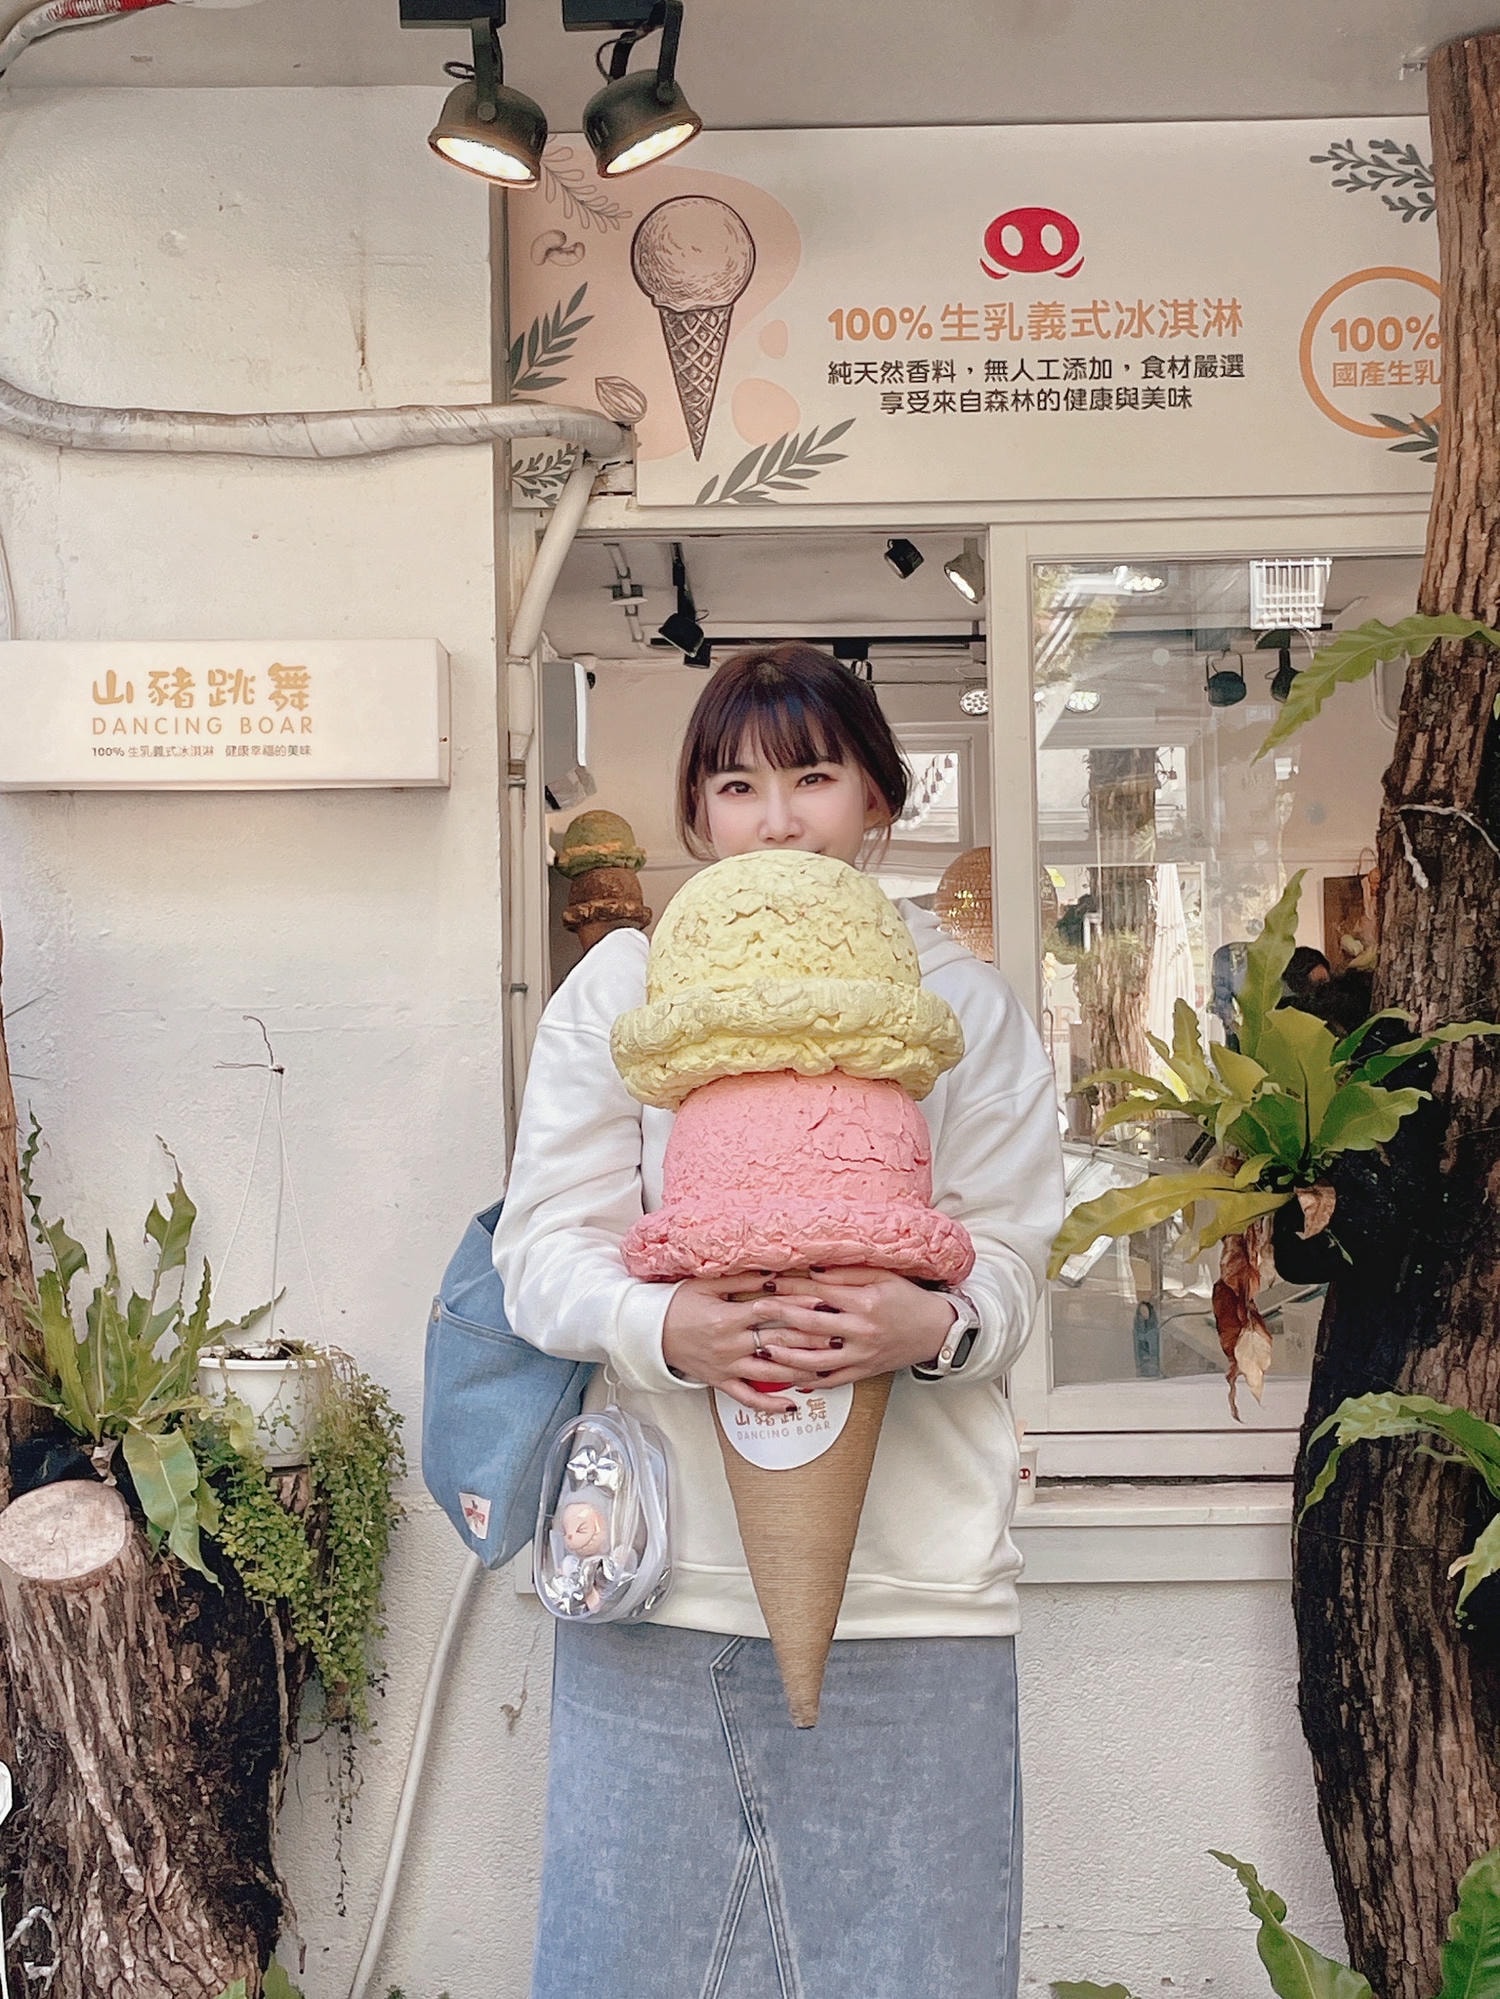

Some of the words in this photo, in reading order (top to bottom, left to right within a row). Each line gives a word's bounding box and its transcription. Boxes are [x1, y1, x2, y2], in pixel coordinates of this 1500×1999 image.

[1330, 313, 1441, 352] 100%
[1332, 359, 1441, 387] 國產生乳
[880, 385, 1193, 415] 享受來自森林的健康與美味
[92, 662, 312, 712] 山豬跳舞
[92, 717, 222, 735] DANCING
[240, 716, 313, 734] BOAR
[736, 1428, 790, 1441] DANCING
[796, 1420, 831, 1436] BOAR
